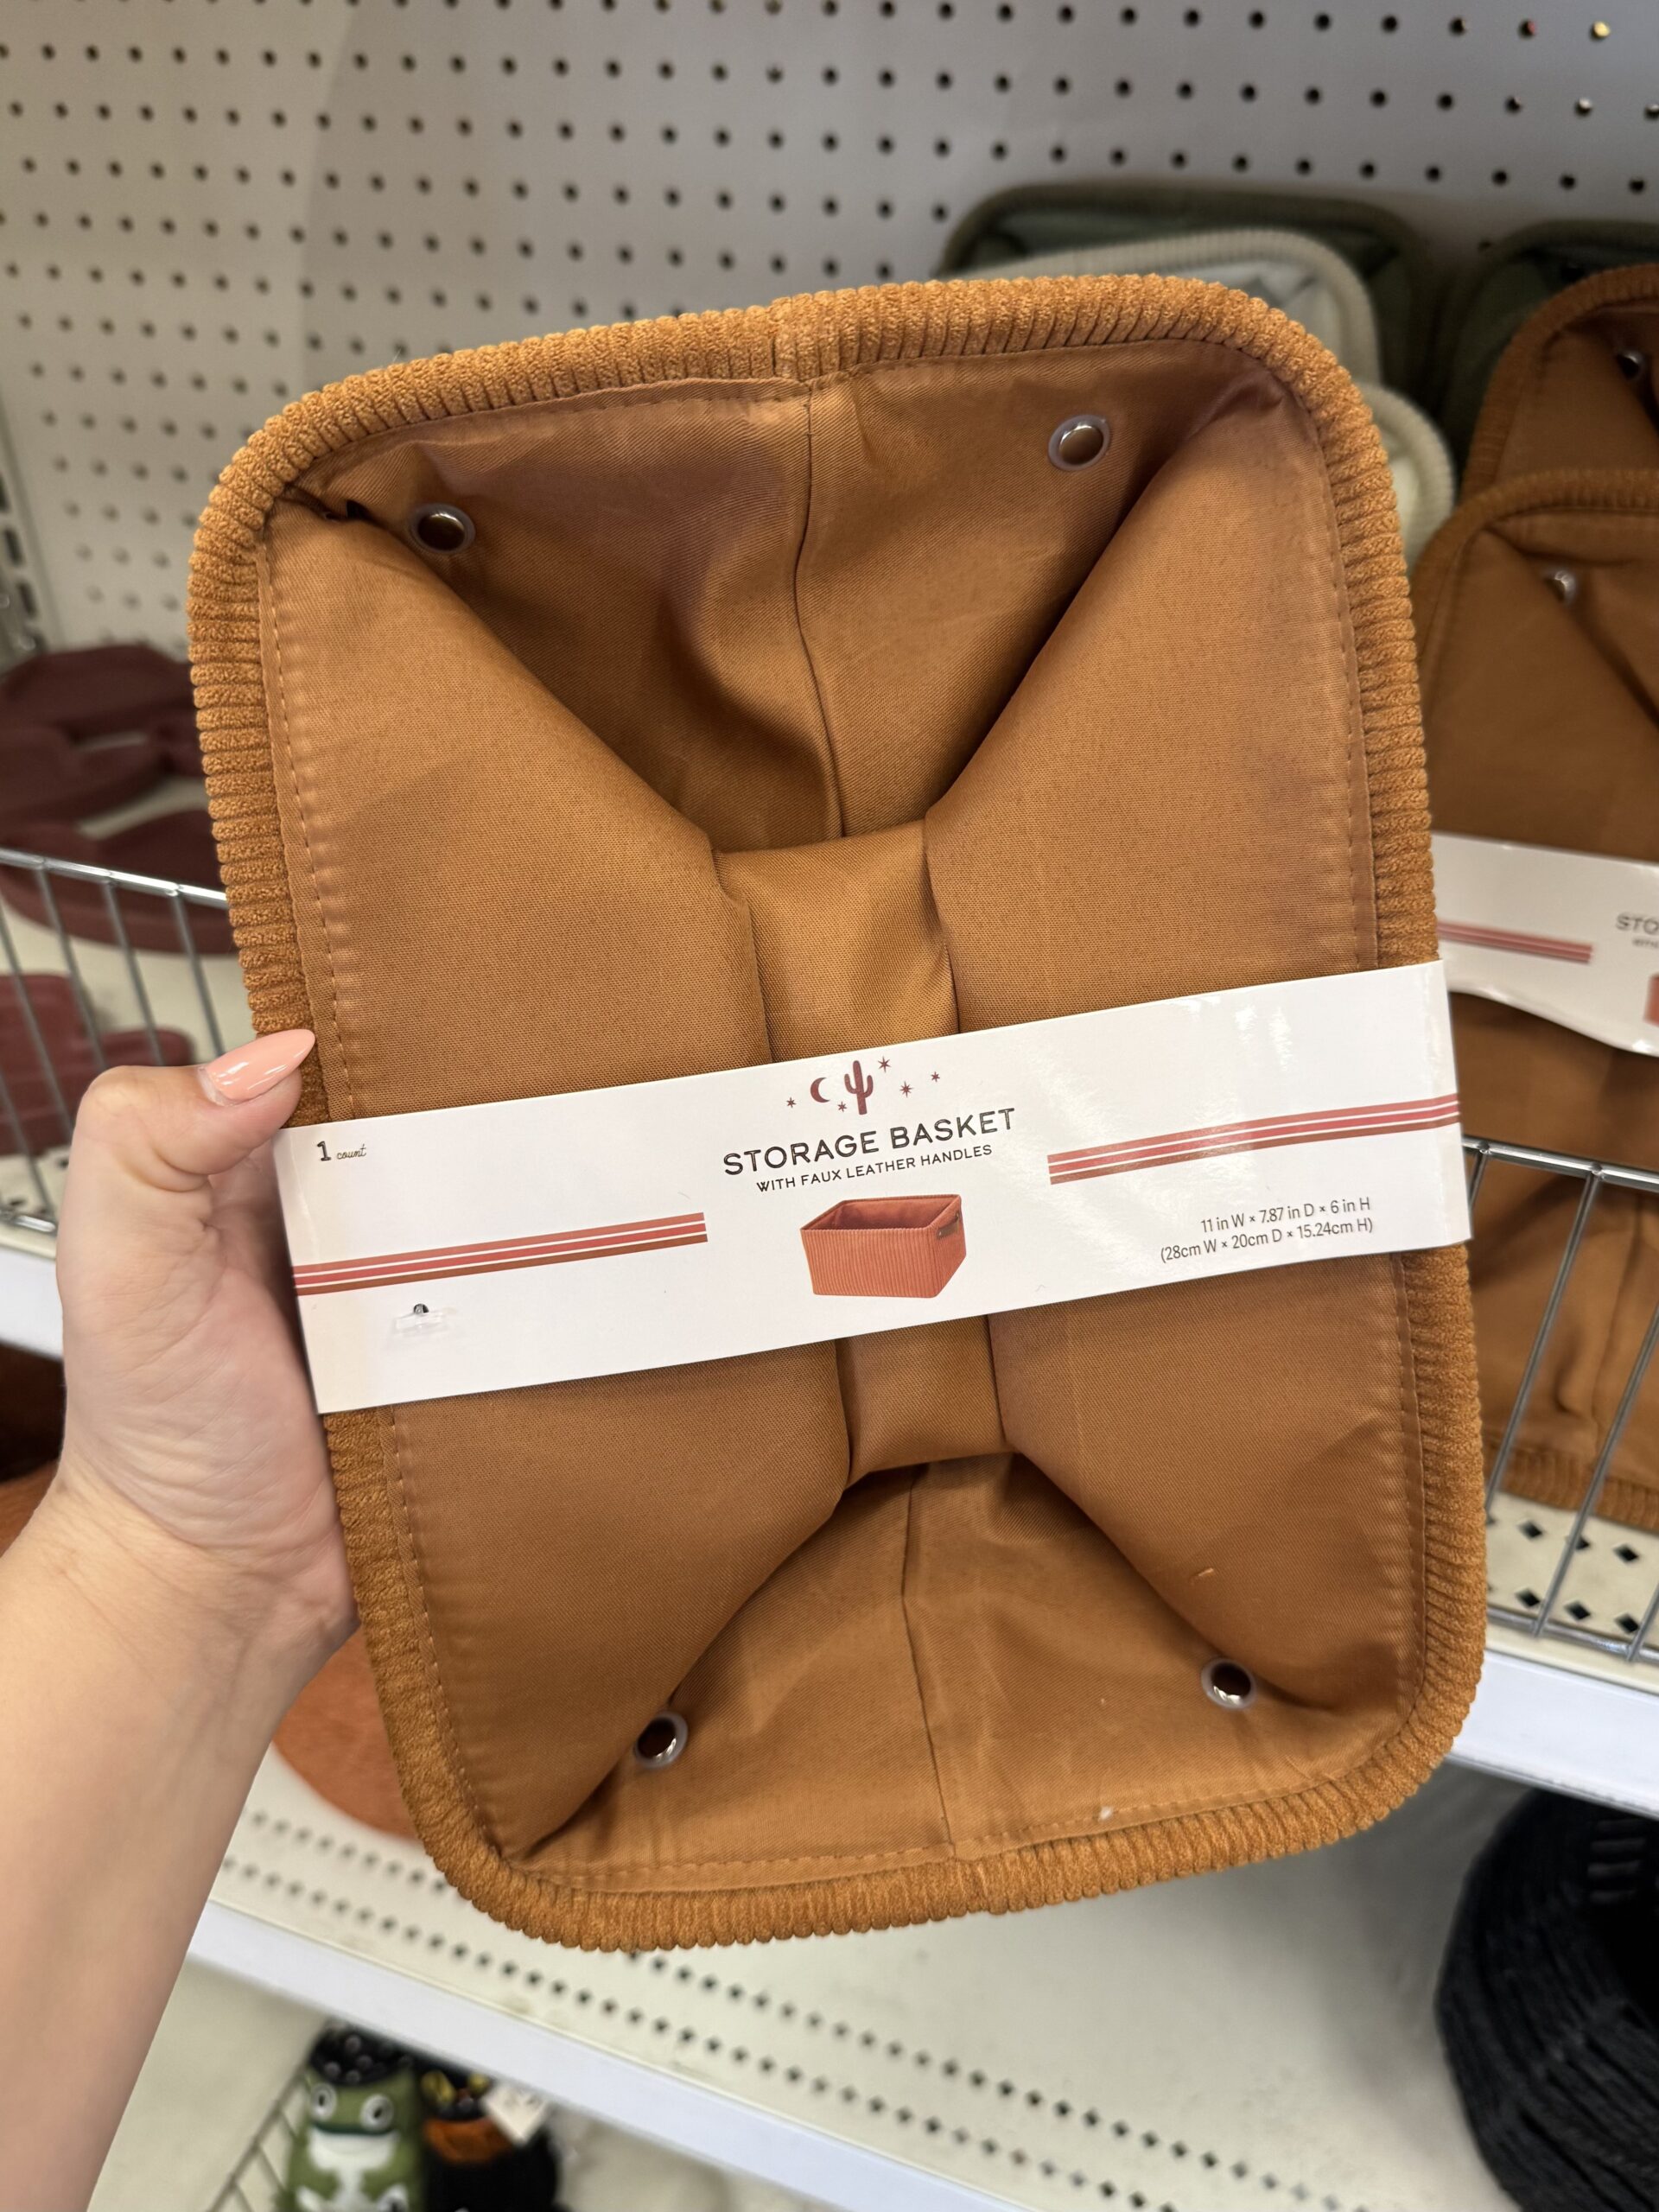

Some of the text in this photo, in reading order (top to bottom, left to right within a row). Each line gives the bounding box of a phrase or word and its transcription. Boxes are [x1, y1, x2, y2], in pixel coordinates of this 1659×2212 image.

[317, 1141, 366, 1161] 1 count
[723, 1108, 1015, 1175] STORAGE BASKET
[757, 1145, 993, 1192] WITH FAUX LEATHER HANDLES
[1201, 1219, 1213, 1233] 11
[1217, 1217, 1229, 1230] in
[1231, 1213, 1244, 1228] W
[1259, 1207, 1284, 1224] 7.87
[1287, 1205, 1300, 1219] in
[1304, 1203, 1314, 1217] D
[1331, 1200, 1339, 1214] 6
[1343, 1198, 1356, 1211] in
[1360, 1197, 1370, 1211] H
[1160, 1243, 1201, 1263] (28cm
[1204, 1239, 1217, 1254] W
[1231, 1234, 1268, 1249] 20cm
[1272, 1229, 1282, 1243] D
[1297, 1222, 1353, 1239] 15.24cm
[1357, 1217, 1373, 1234] H)
